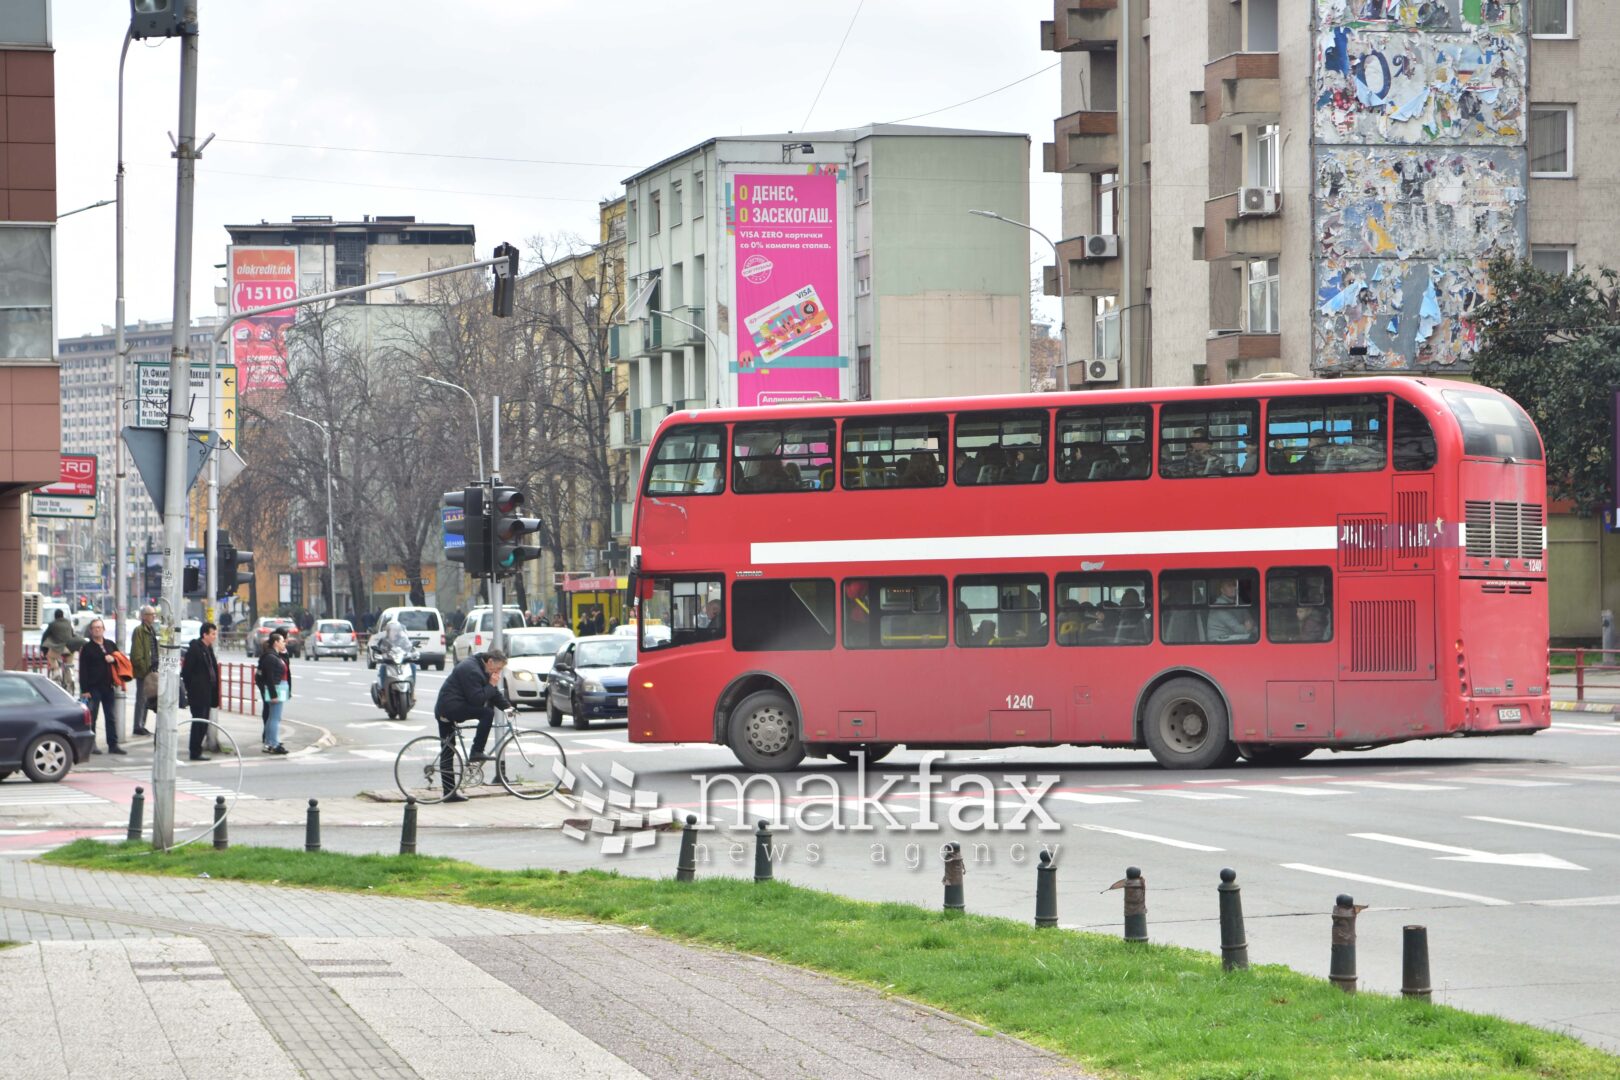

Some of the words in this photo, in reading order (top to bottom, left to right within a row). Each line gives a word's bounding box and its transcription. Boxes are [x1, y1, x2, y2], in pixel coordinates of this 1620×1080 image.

[740, 185, 748, 200] 0
[752, 186, 798, 204] ДЕНЕС,
[740, 208, 748, 222] 0
[753, 208, 832, 223] ЗАСЕКОГАШ.
[246, 286, 293, 300] 15110
[796, 288, 812, 299] VISA
[1529, 560, 1542, 571] 1240
[1005, 694, 1034, 709] 1240
